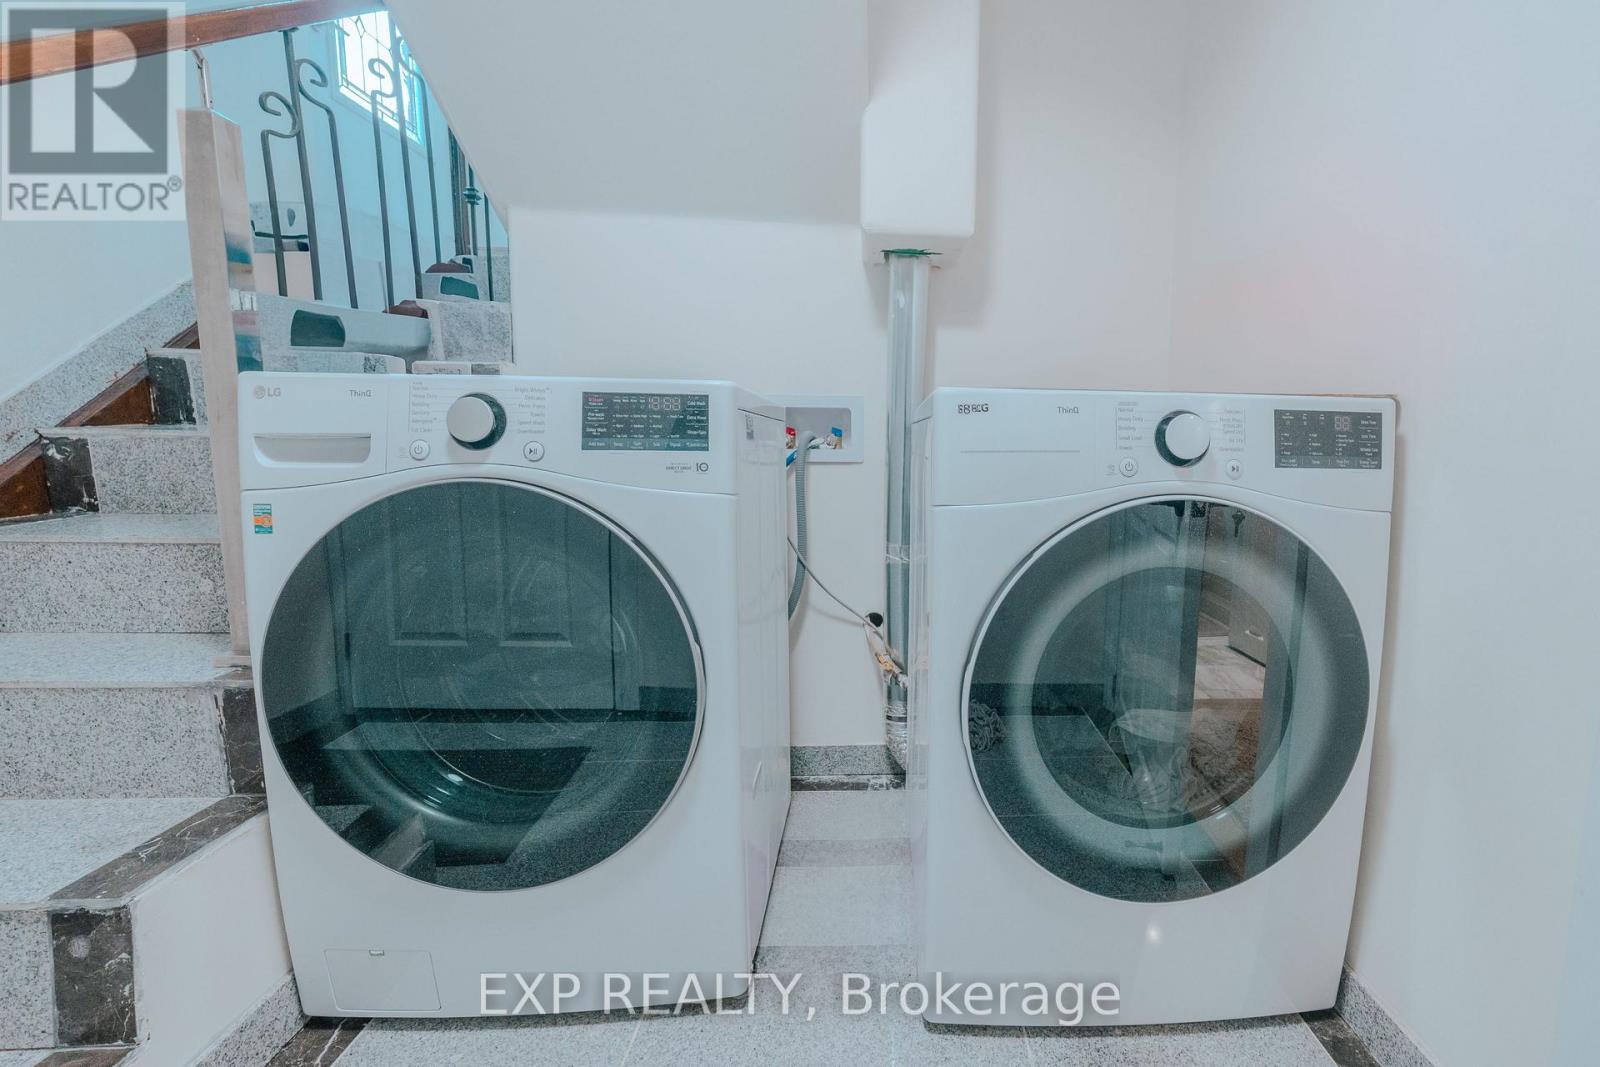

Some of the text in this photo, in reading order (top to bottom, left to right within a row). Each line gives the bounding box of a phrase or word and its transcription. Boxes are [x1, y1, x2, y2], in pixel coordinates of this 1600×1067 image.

[267, 387, 282, 397] LG
[348, 389, 372, 398] ThinQ
[1057, 406, 1080, 414] ThinQ
